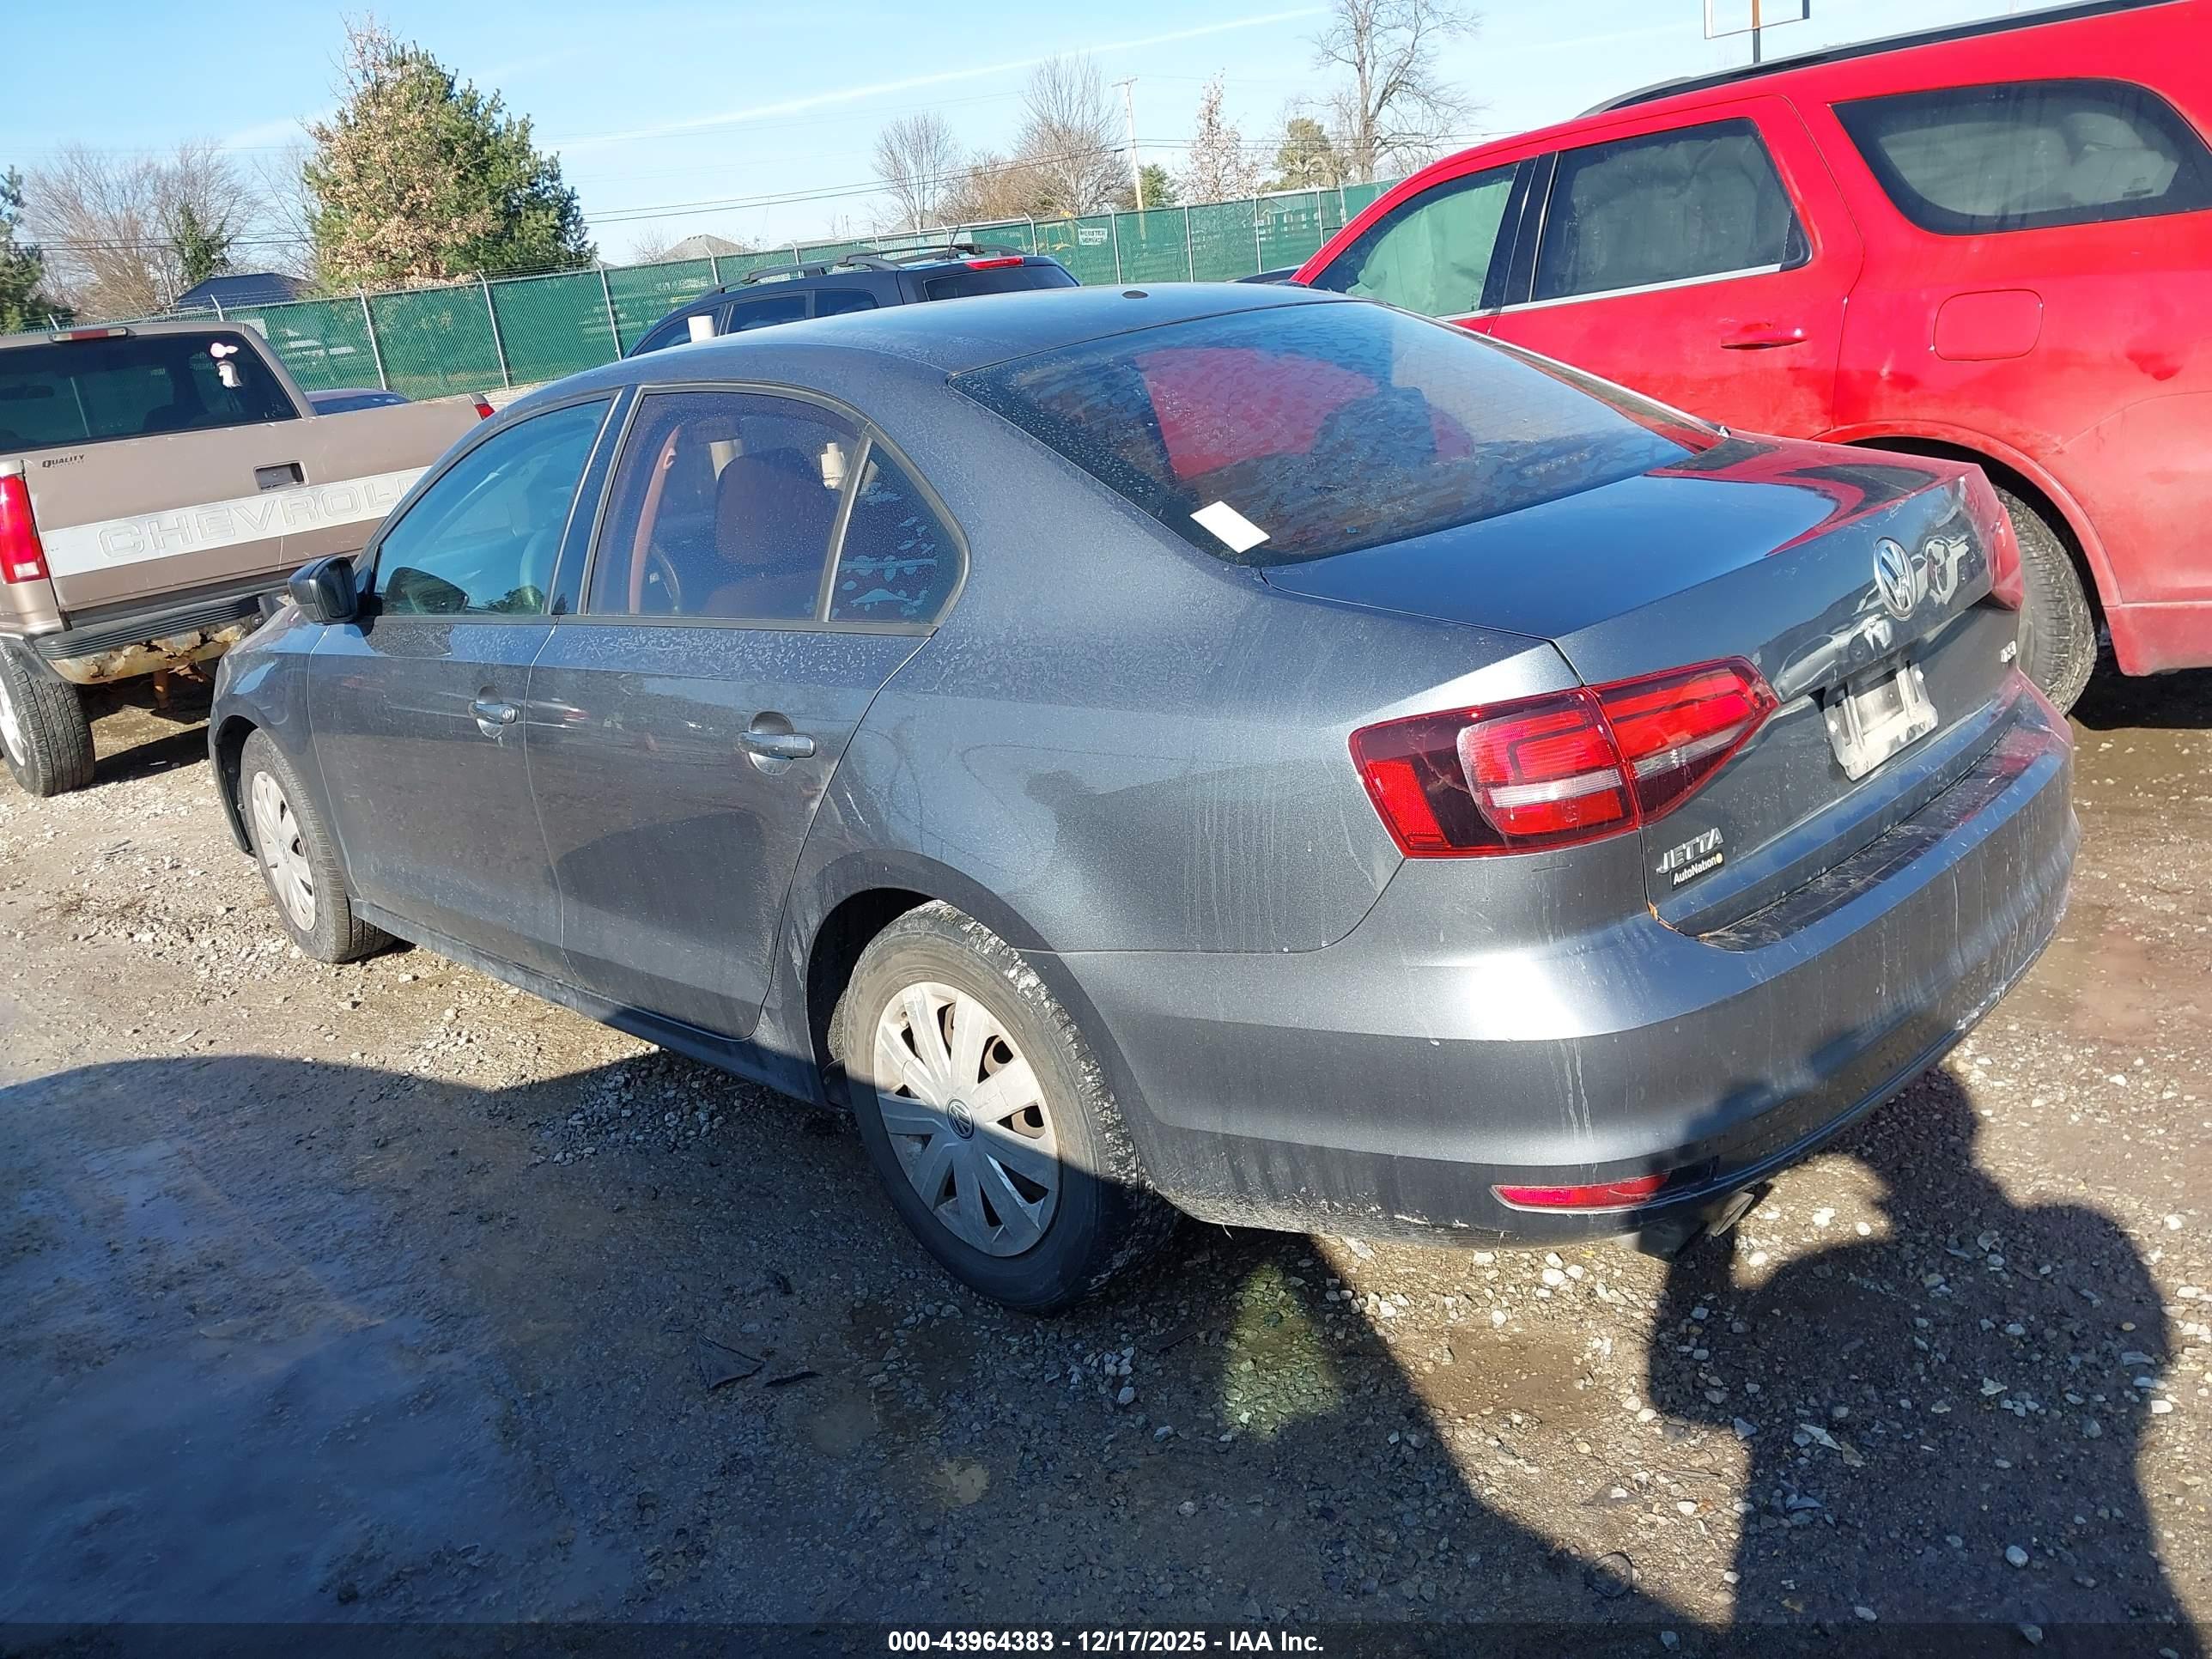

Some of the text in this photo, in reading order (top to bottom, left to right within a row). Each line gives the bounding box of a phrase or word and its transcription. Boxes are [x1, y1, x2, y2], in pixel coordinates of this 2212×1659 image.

[42, 454, 84, 468] QUALITY
[1656, 827, 1724, 874] JETTA
[1673, 854, 1717, 885] AutoNation
